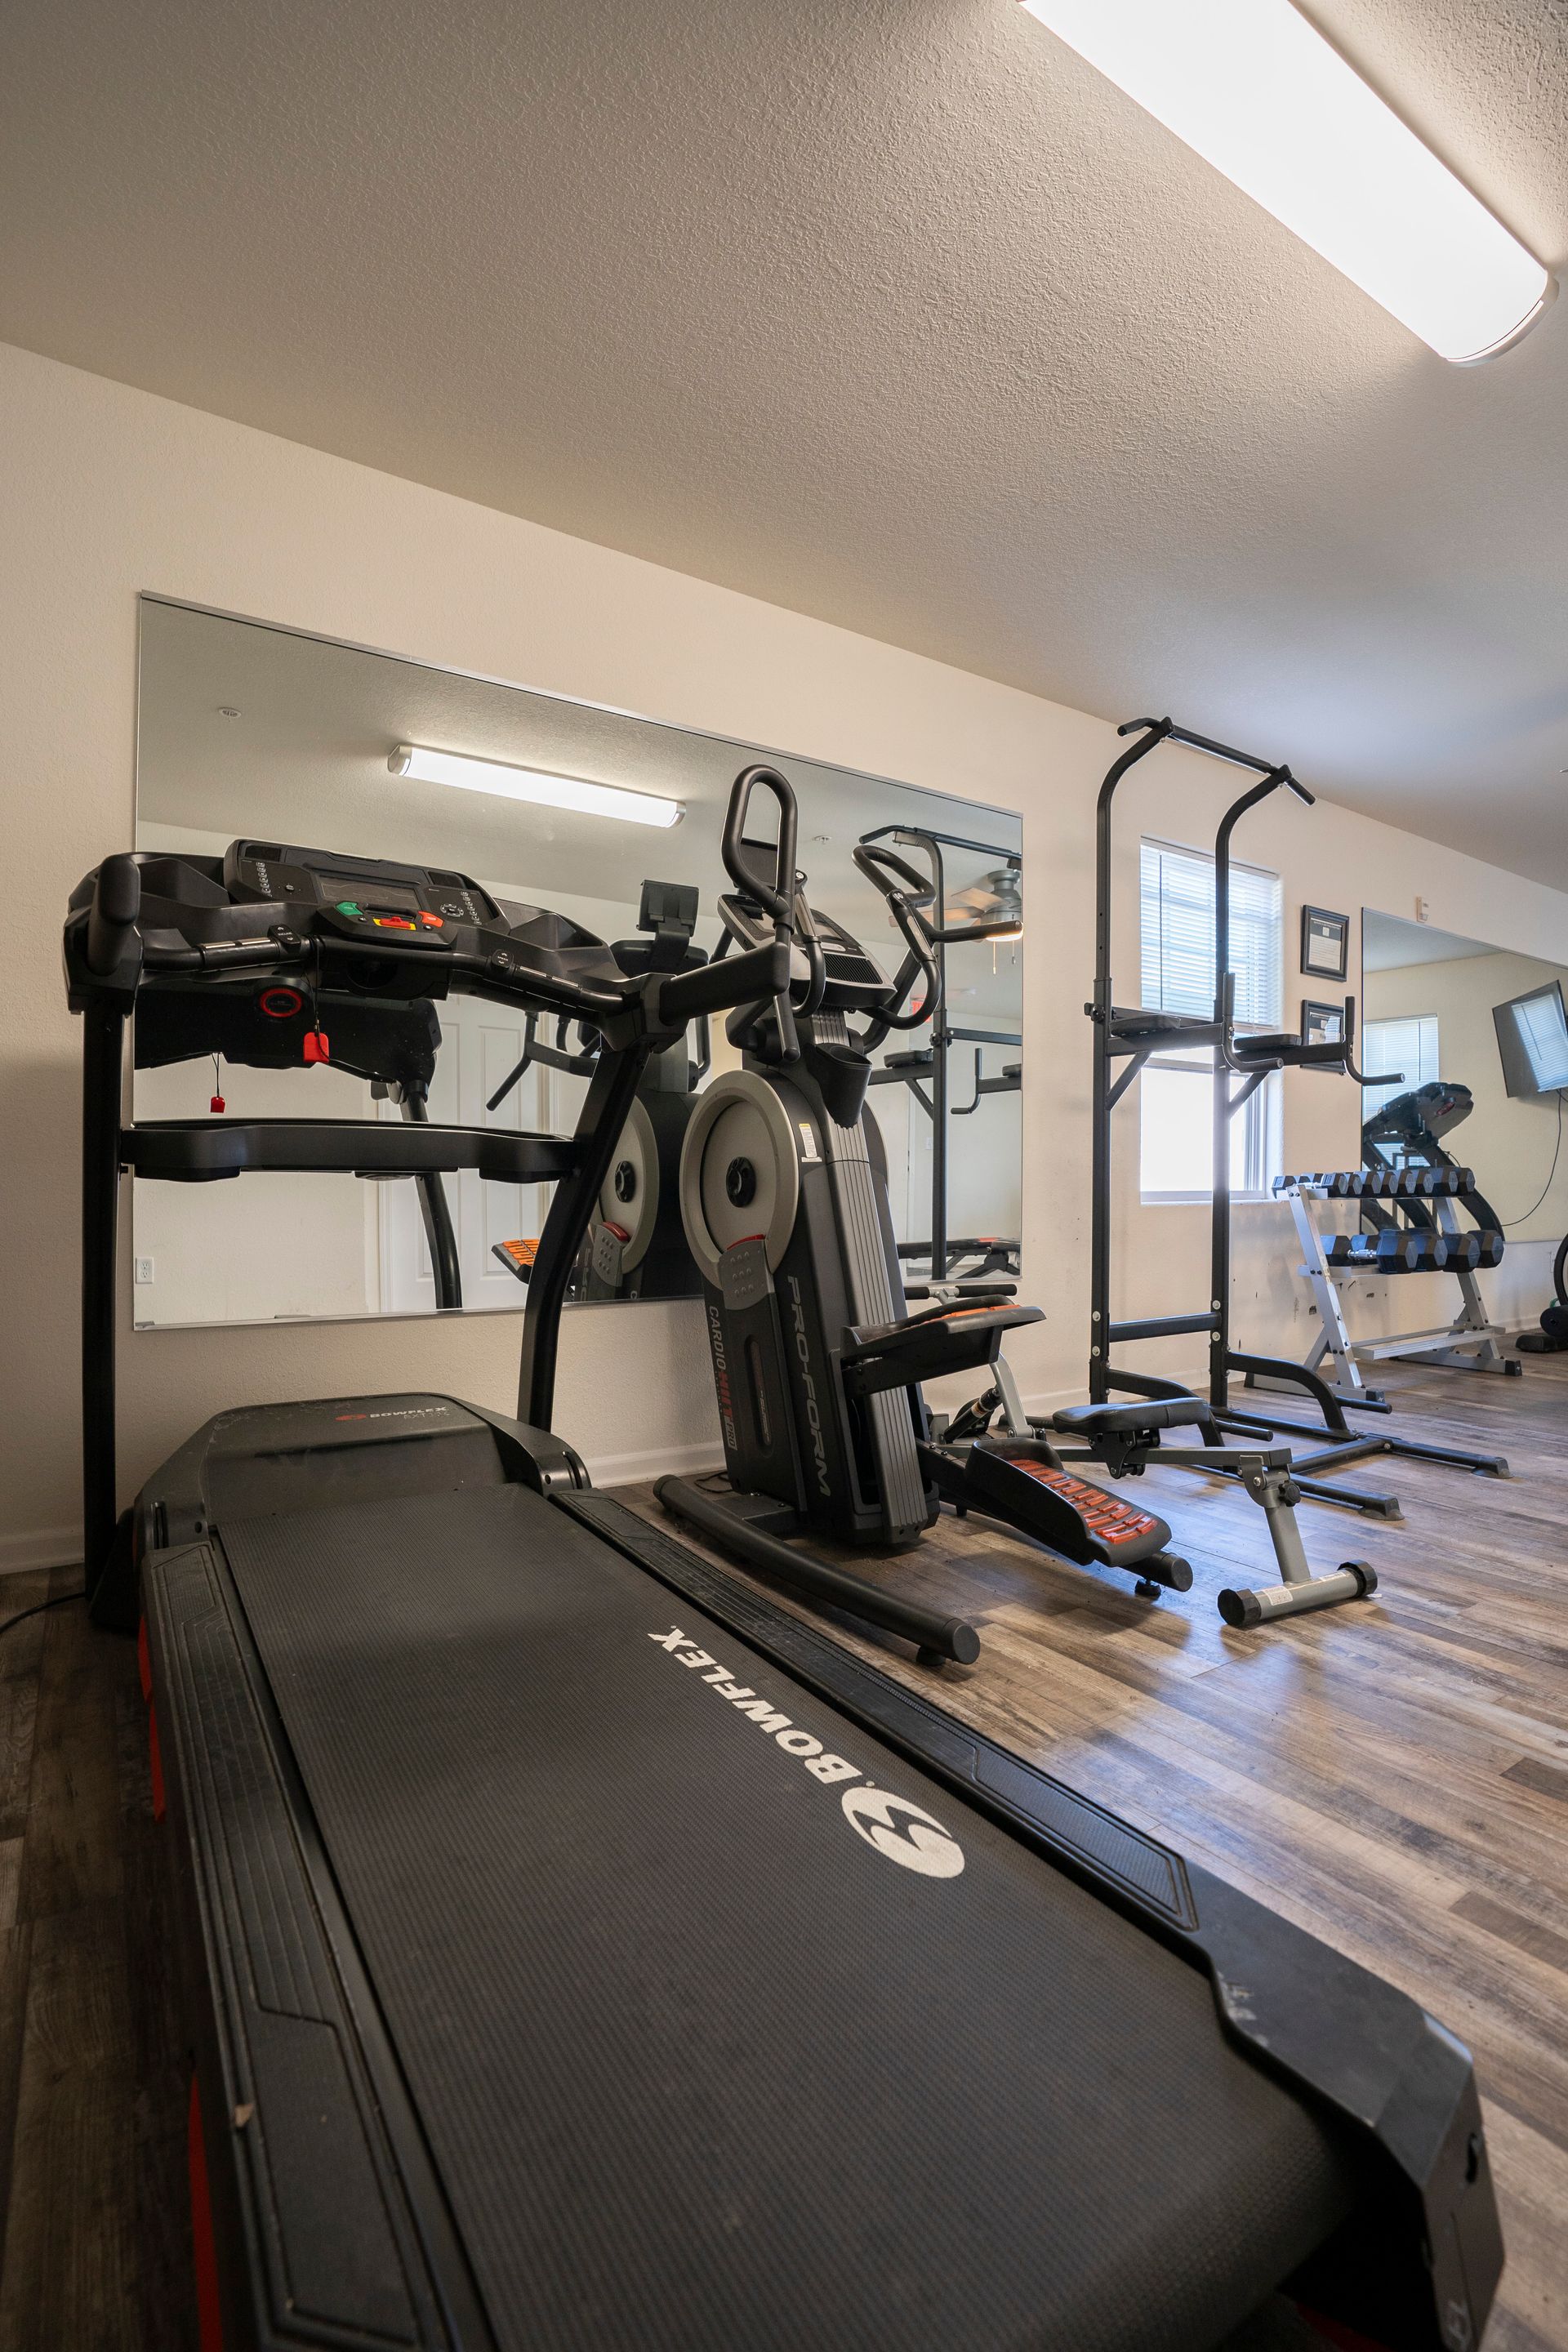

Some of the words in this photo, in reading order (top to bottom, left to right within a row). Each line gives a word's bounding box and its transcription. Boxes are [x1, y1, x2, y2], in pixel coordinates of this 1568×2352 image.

[709, 1306, 727, 1371] CARDIO
[787, 1276, 831, 1497] PRO-FORM
[370, 1406, 448, 1419] BOWFLEX
[648, 1628, 863, 1784] BOWFLEX
